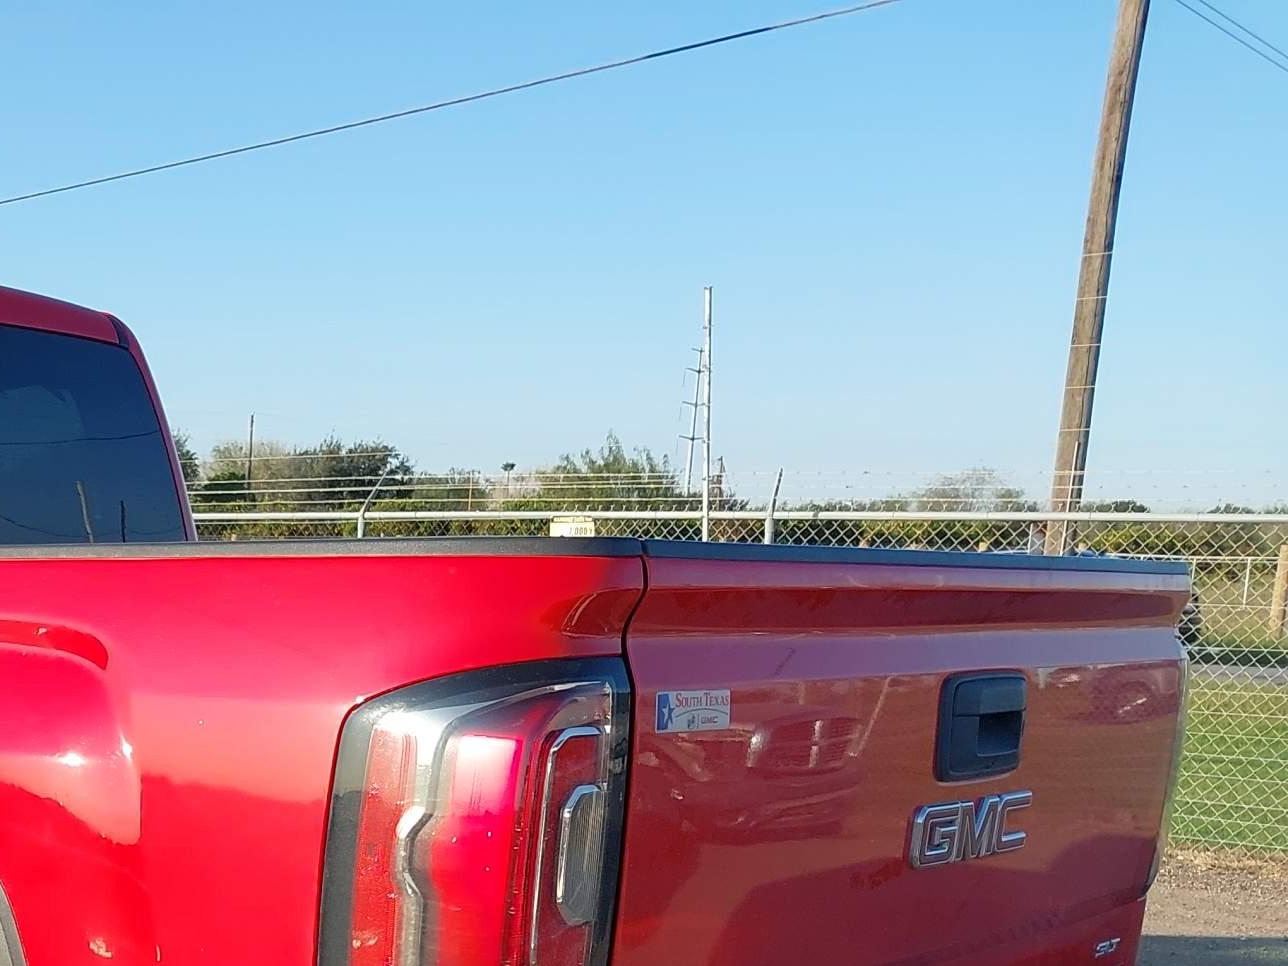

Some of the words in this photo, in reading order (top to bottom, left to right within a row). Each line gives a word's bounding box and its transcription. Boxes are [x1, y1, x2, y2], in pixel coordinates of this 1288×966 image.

[675, 693, 702, 708] SOUTH
[704, 692, 730, 706] TEXAS
[911, 790, 1033, 869] GMC
